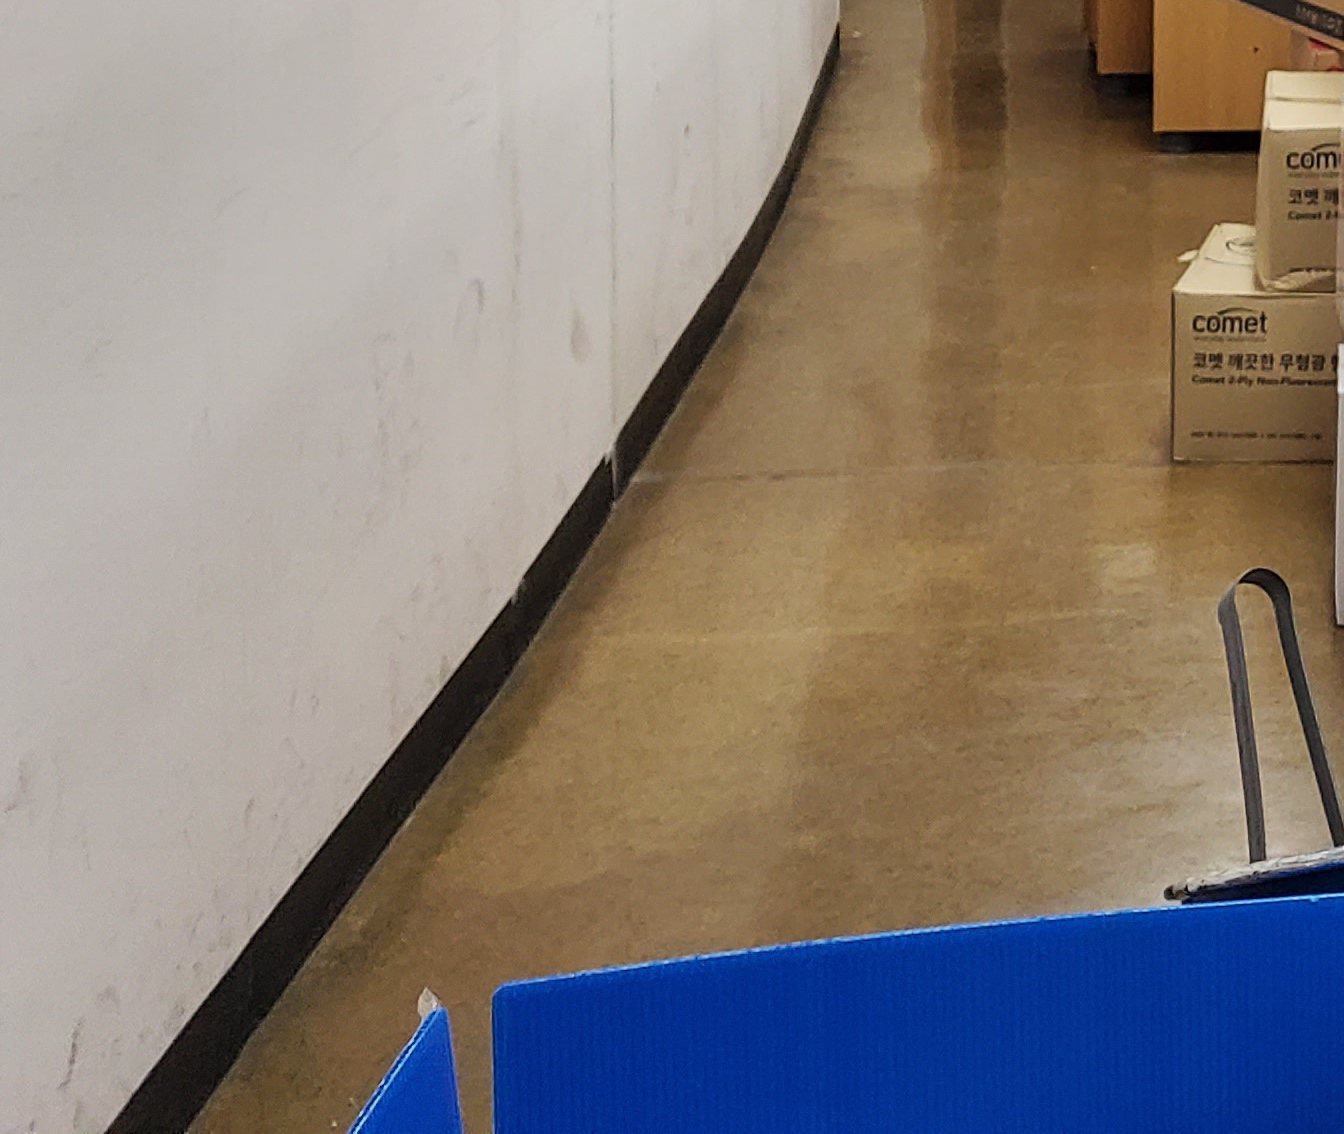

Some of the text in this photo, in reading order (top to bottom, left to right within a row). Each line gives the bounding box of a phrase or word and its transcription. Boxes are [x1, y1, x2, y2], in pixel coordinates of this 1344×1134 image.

[1286, 151, 1341, 170] com
[1192, 310, 1268, 333] comet
[1193, 352, 1224, 370] 코멧
[1228, 352, 1274, 371] 깨끗한
